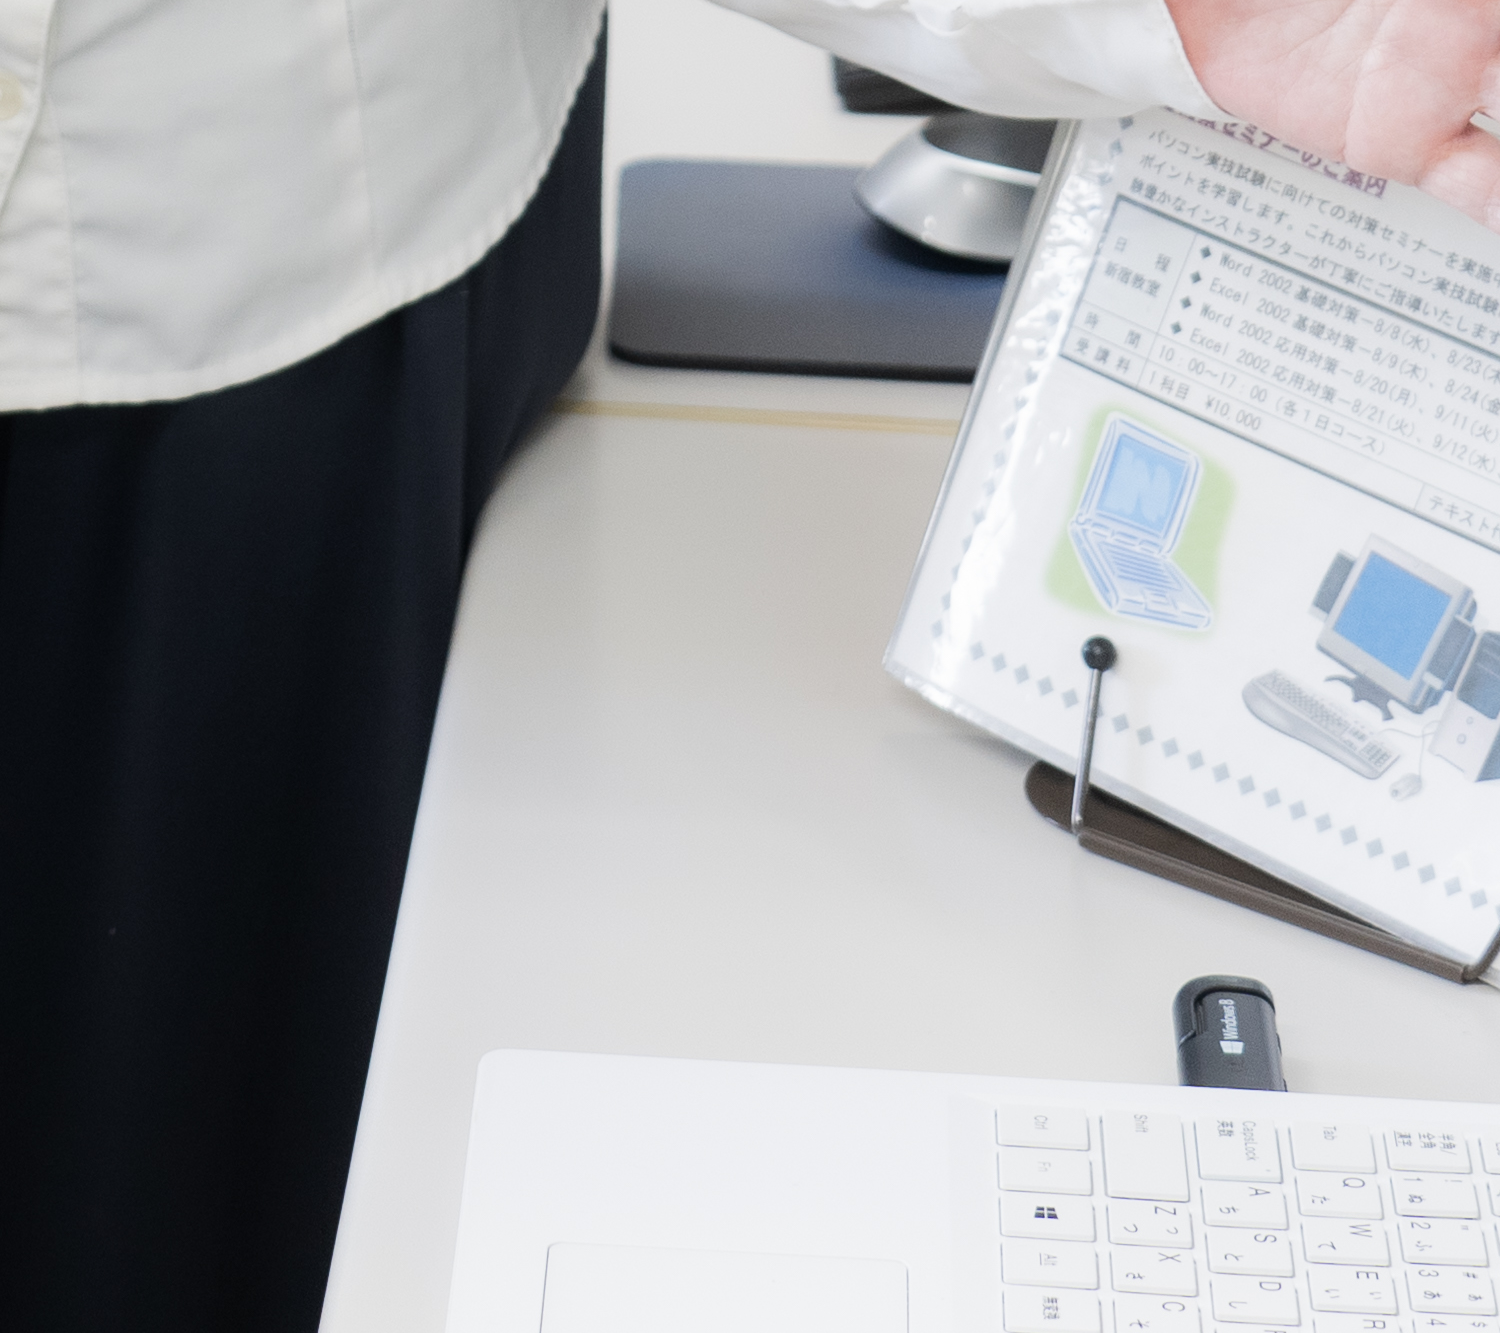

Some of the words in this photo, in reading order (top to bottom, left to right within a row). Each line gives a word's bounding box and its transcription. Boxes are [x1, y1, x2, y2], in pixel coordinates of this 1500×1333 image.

[1218, 251, 1253, 277] Word
[1258, 269, 1292, 294] 2002
[1103, 261, 1161, 298] 新宿教室
[1209, 276, 1249, 306] Excel
[1256, 298, 1290, 324] 2002
[1199, 302, 1233, 327] Word
[1238, 319, 1272, 344] 2002
[1189, 328, 1229, 356] Excel
[1236, 349, 1270, 374] 2002
[1218, 998, 1235, 1006] 8
[1221, 1005, 1239, 1040] Windows
[1033, 1115, 1048, 1130] Ctrl
[1134, 1114, 1148, 1133] Shift
[1323, 1126, 1336, 1140] Tab
[1241, 1120, 1257, 1161] CapsLock
[1342, 1177, 1366, 1189] Q
[1247, 1186, 1271, 1197] A
[1154, 1205, 1177, 1216] Z
[1349, 1223, 1372, 1238] W
[1410, 1221, 1431, 1229] 2
[1253, 1233, 1277, 1243] S
[1157, 1252, 1181, 1263] X
[1355, 1271, 1379, 1280] E
[1418, 1269, 1439, 1277] 3
[1258, 1281, 1282, 1292] D
[1162, 1301, 1186, 1312] C
[1362, 1319, 1387, 1329] R
